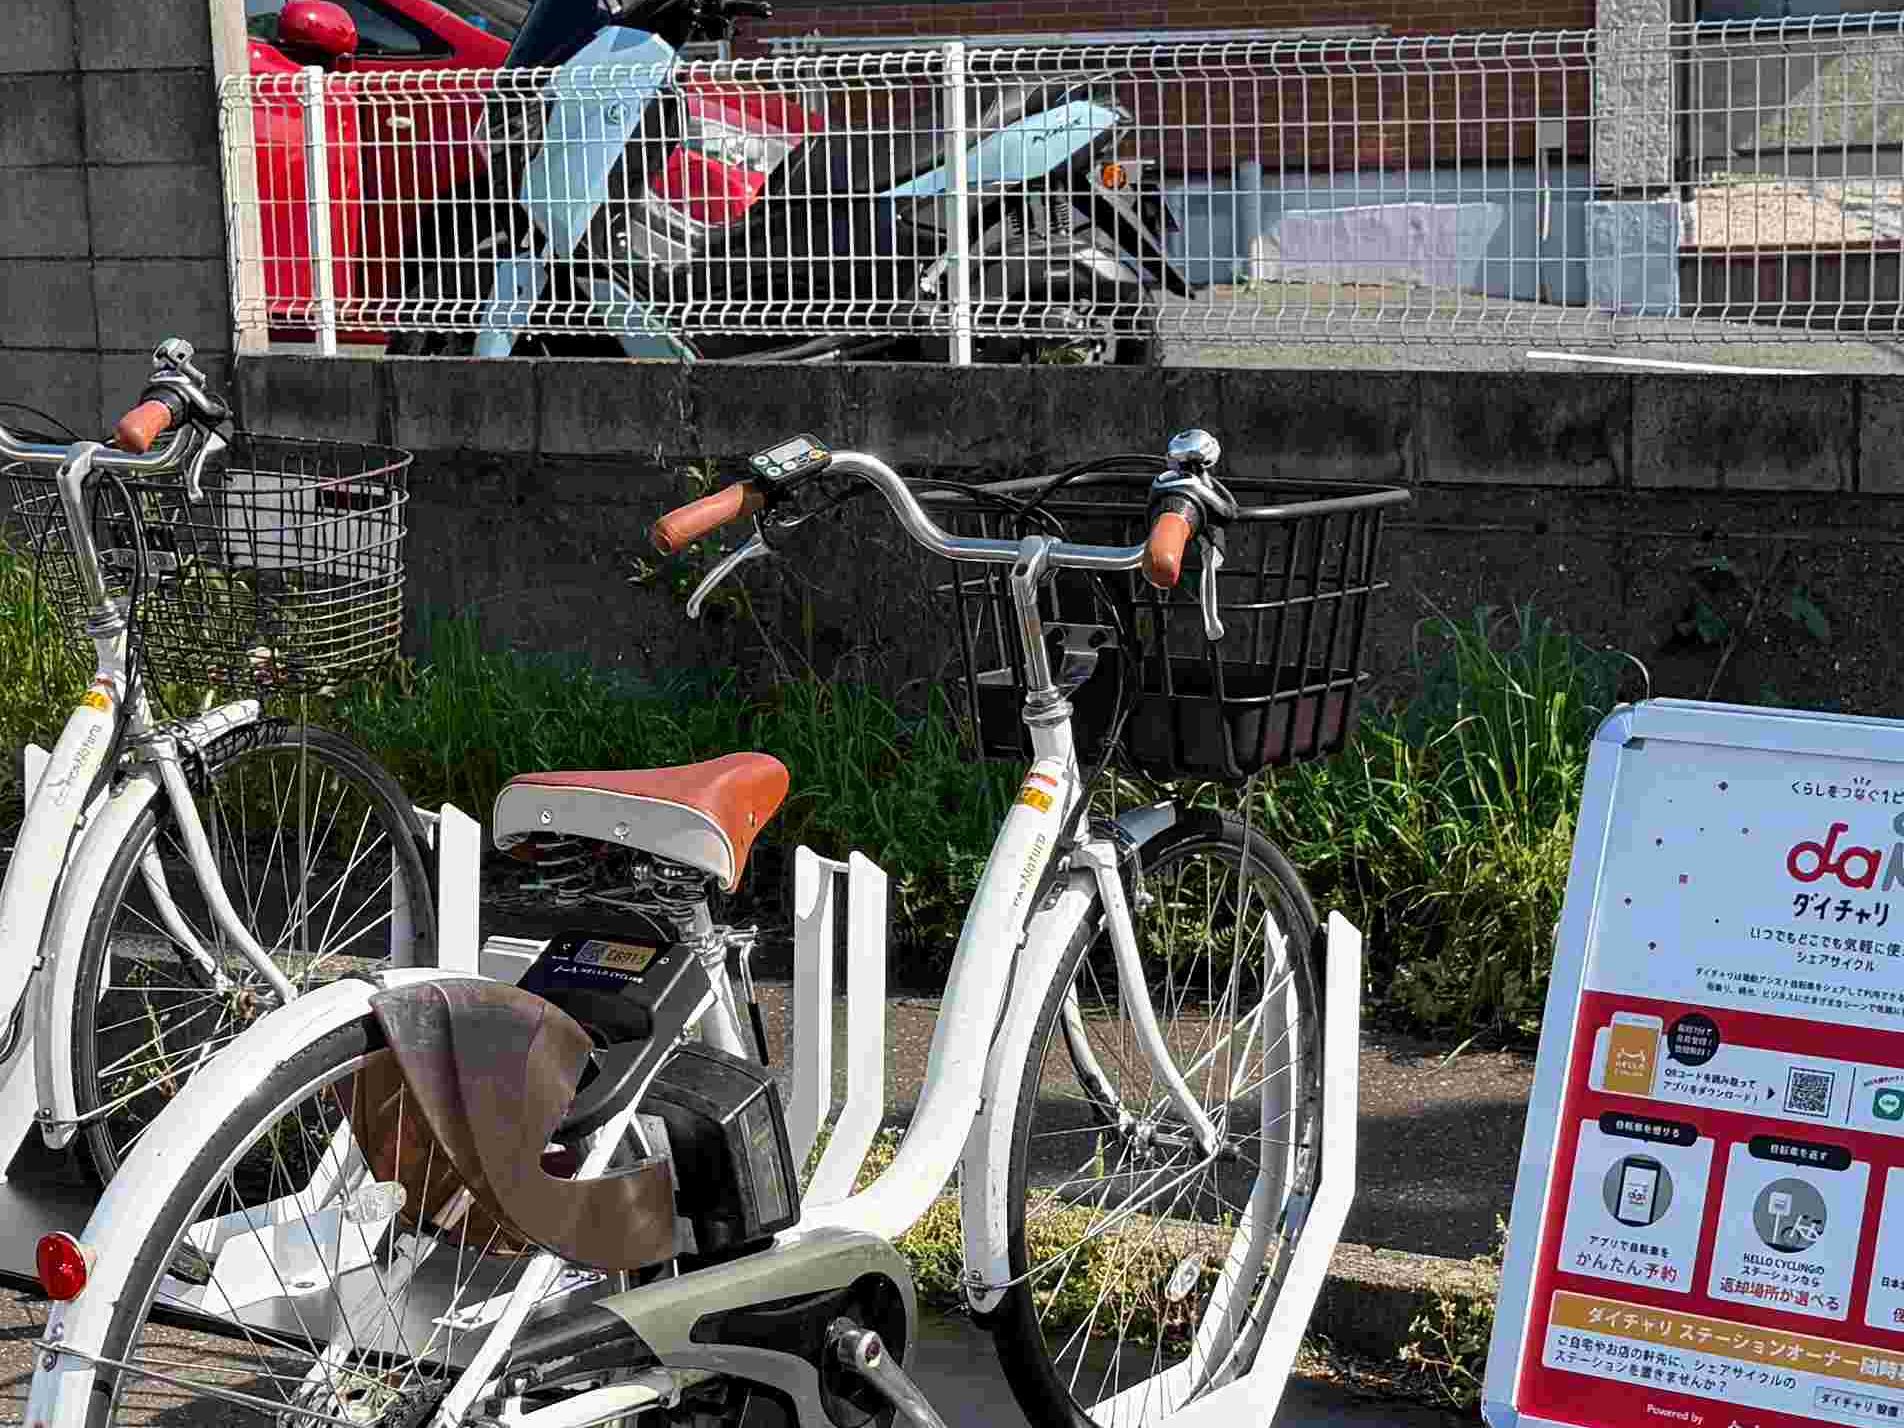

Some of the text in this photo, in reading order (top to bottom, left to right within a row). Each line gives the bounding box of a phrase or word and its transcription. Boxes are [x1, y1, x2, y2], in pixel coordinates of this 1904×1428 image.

[1792, 892, 1890, 927] ダイチャリ
[1796, 950, 1876, 972] シェアサイクル
[1576, 1252, 1680, 1283] かんたん予約
[1743, 1253, 1772, 1268] HELLO
[1719, 1276, 1840, 1312] 返却場所が選べる
[1587, 1307, 1673, 1336] ダイチャリ
[1647, 1403, 1704, 1427] Powered by
